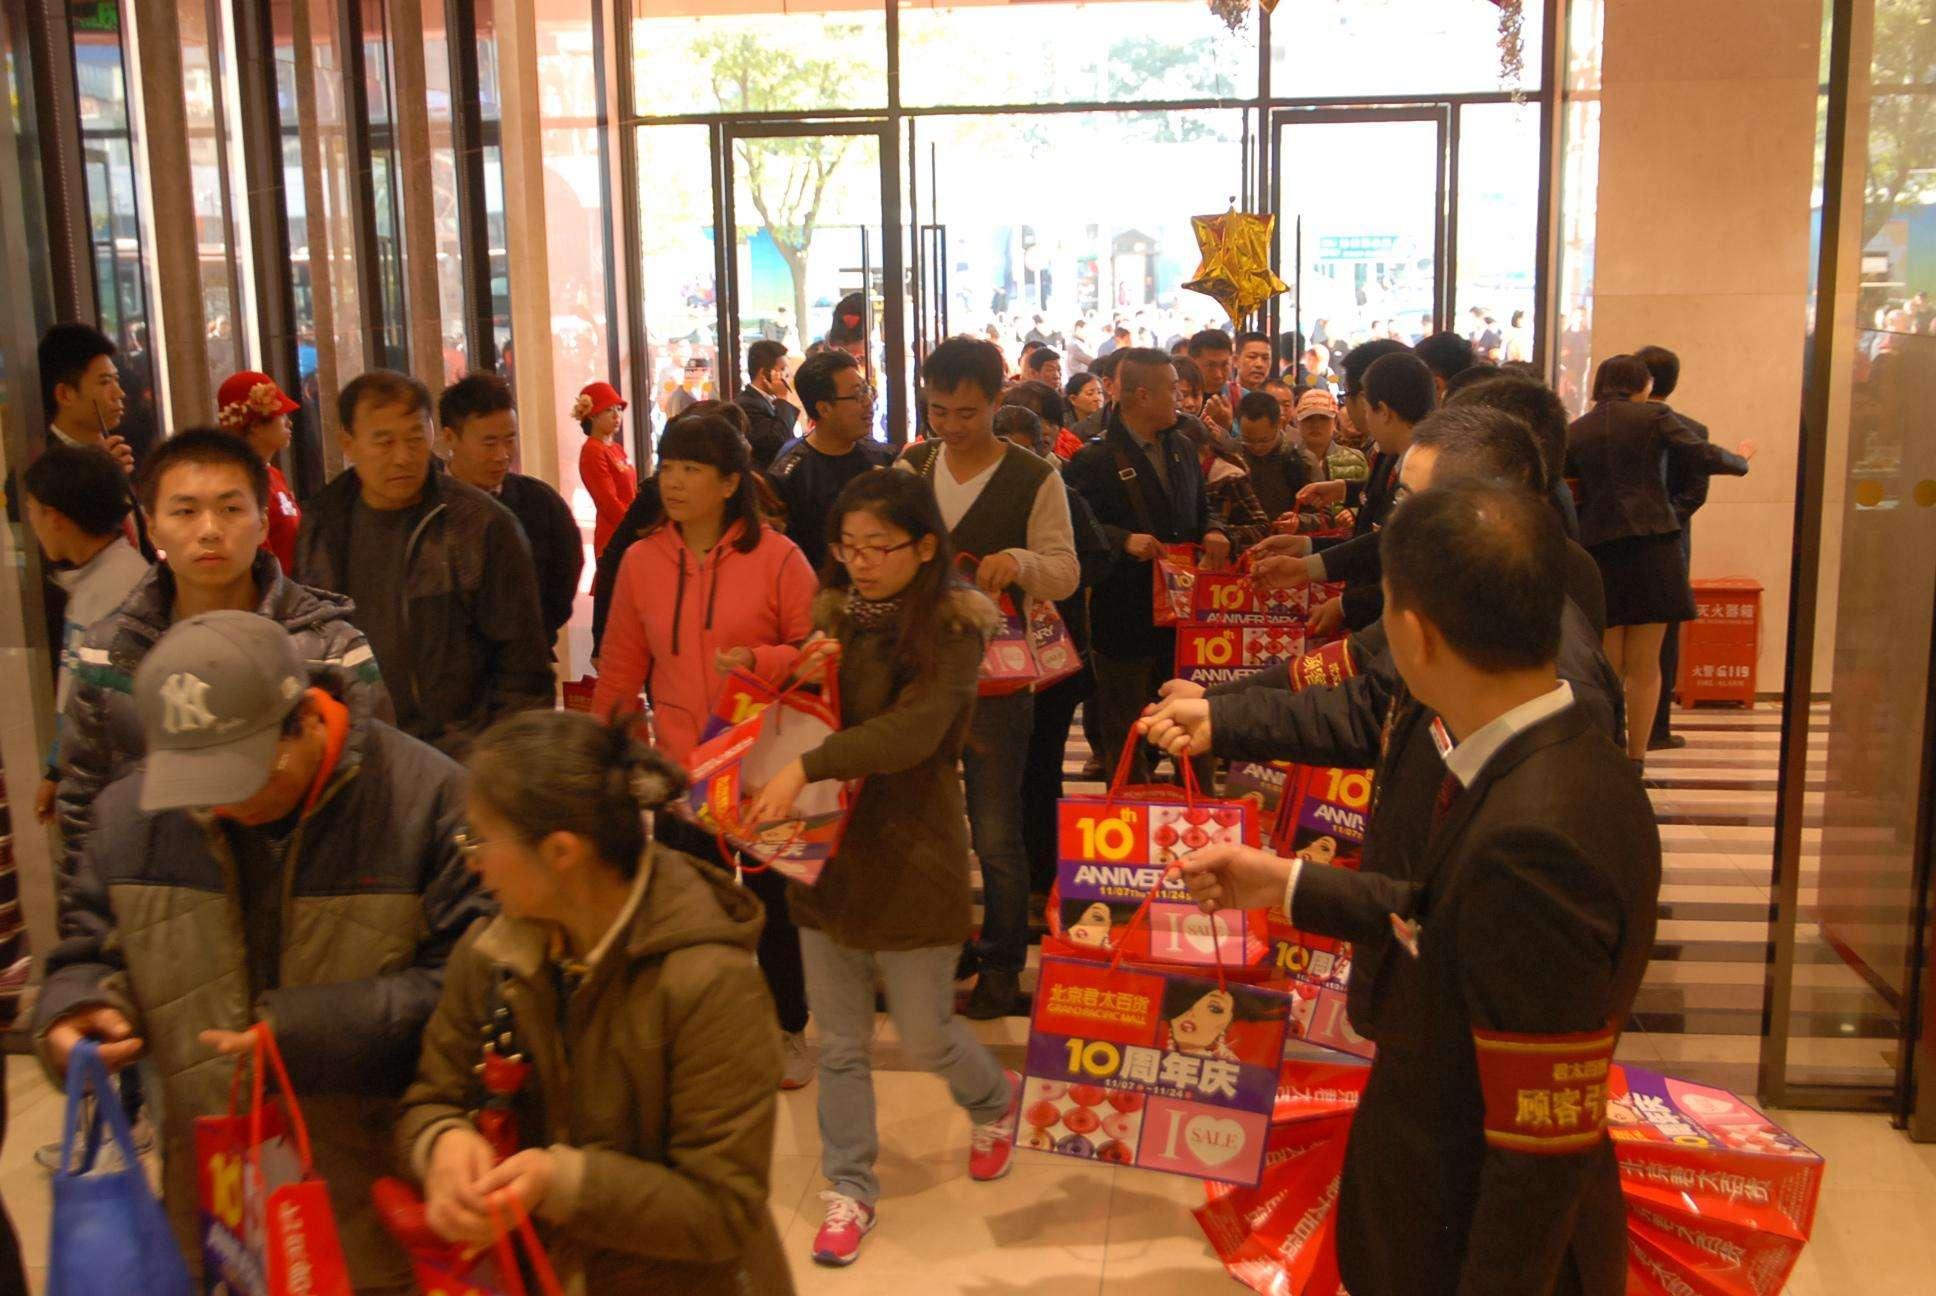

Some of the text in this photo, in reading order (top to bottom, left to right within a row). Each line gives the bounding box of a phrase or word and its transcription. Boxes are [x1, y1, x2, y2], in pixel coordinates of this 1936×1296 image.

[159, 672, 218, 734] NY
[1075, 807, 1138, 861] 10th
[1158, 1108, 1238, 1160] I SALE
